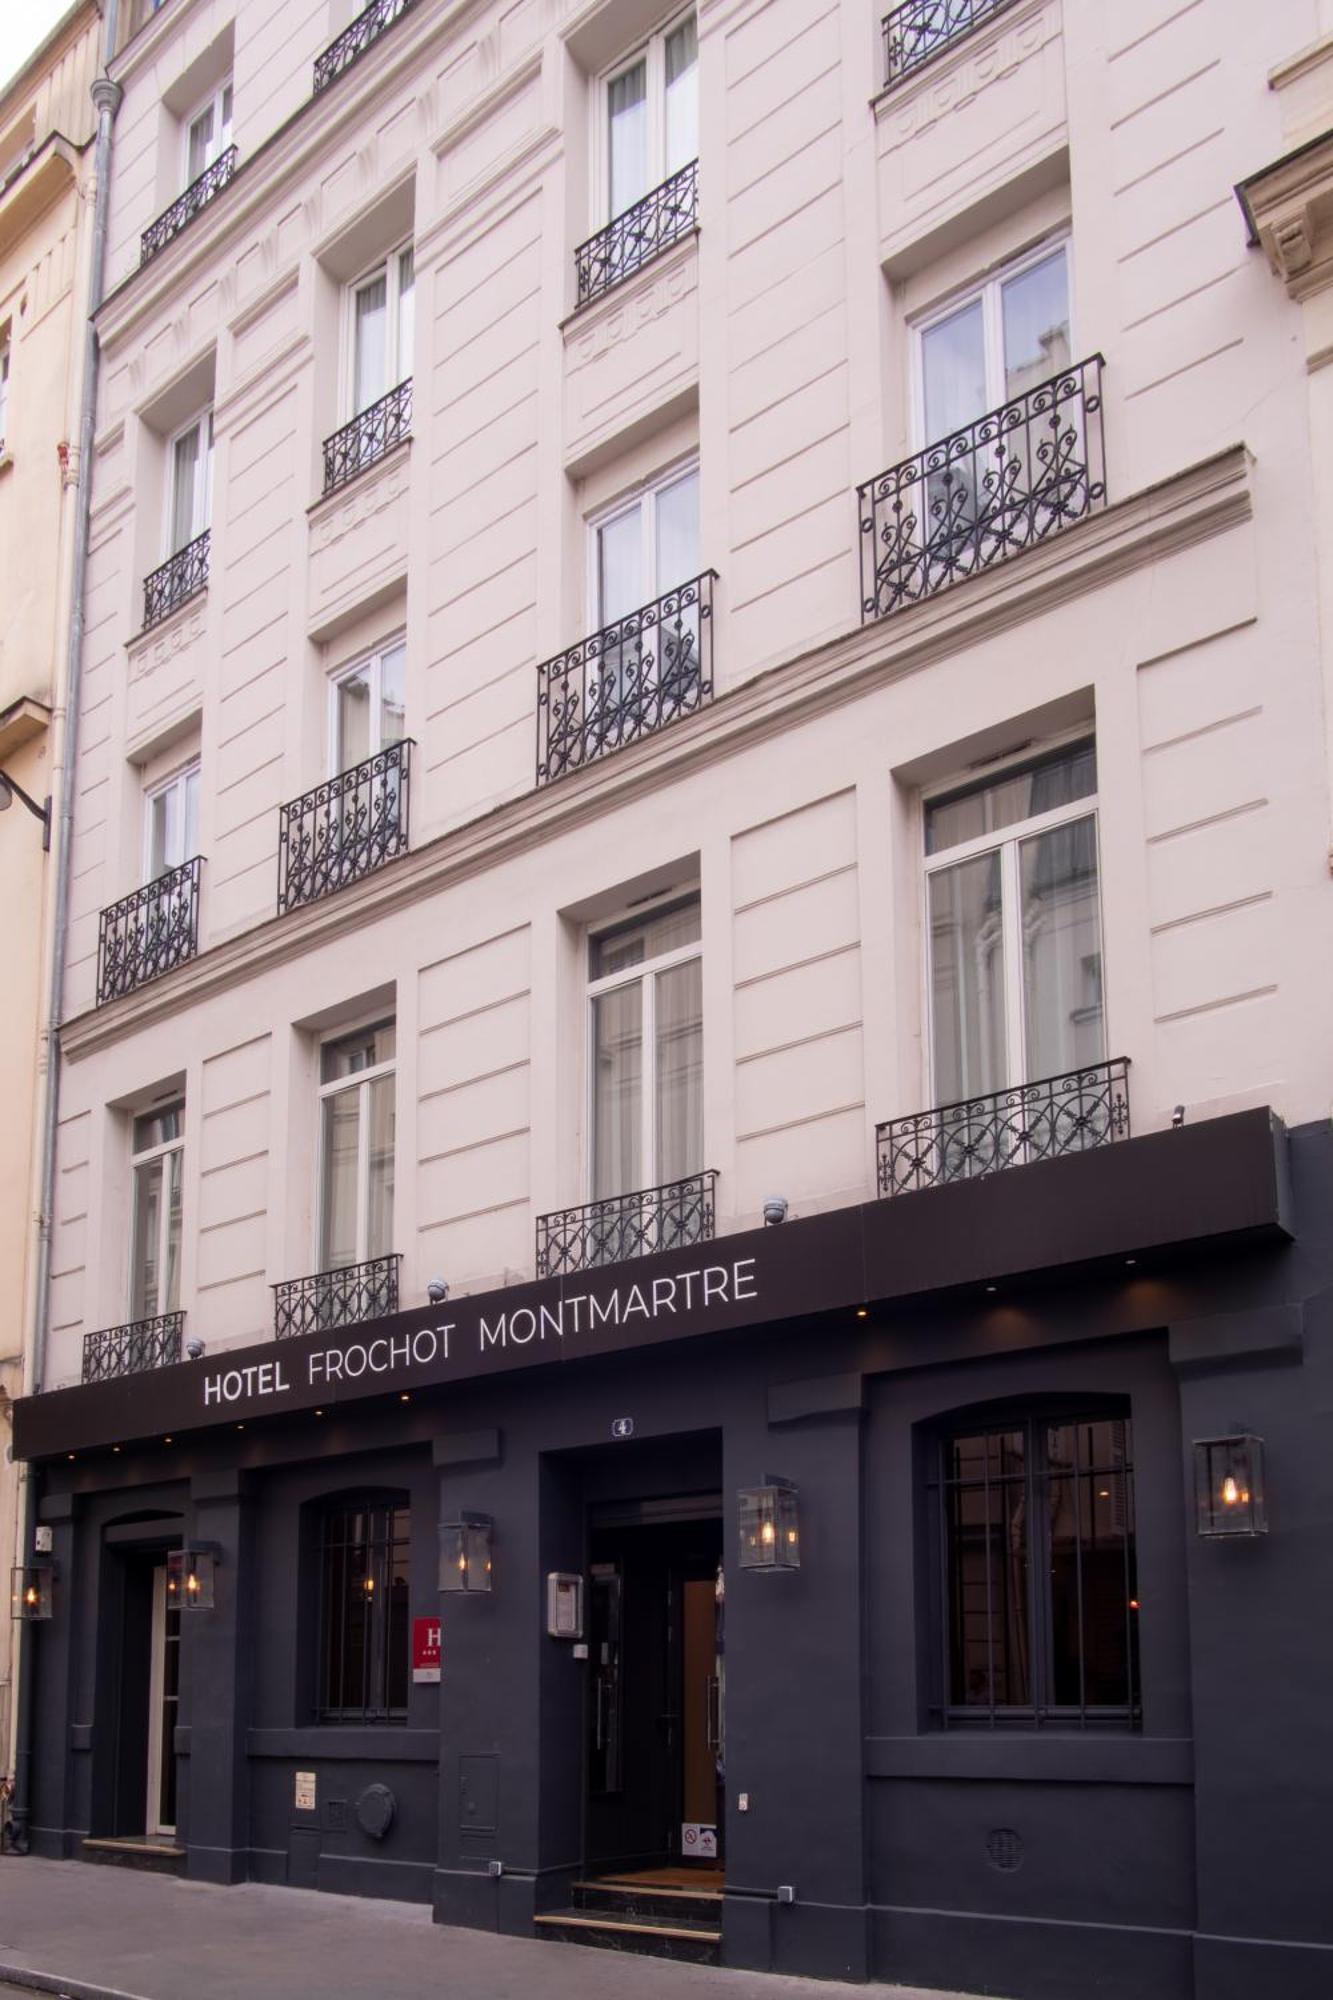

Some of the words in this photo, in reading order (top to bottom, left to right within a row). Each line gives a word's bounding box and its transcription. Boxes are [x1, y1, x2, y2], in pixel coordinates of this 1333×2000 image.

[204, 1361, 290, 1406] HOTEL
[308, 1323, 456, 1385] FROCHOT
[479, 1257, 758, 1352] MONTMARTRE
[617, 1420, 627, 1435] 4
[427, 1627, 441, 1648] H
